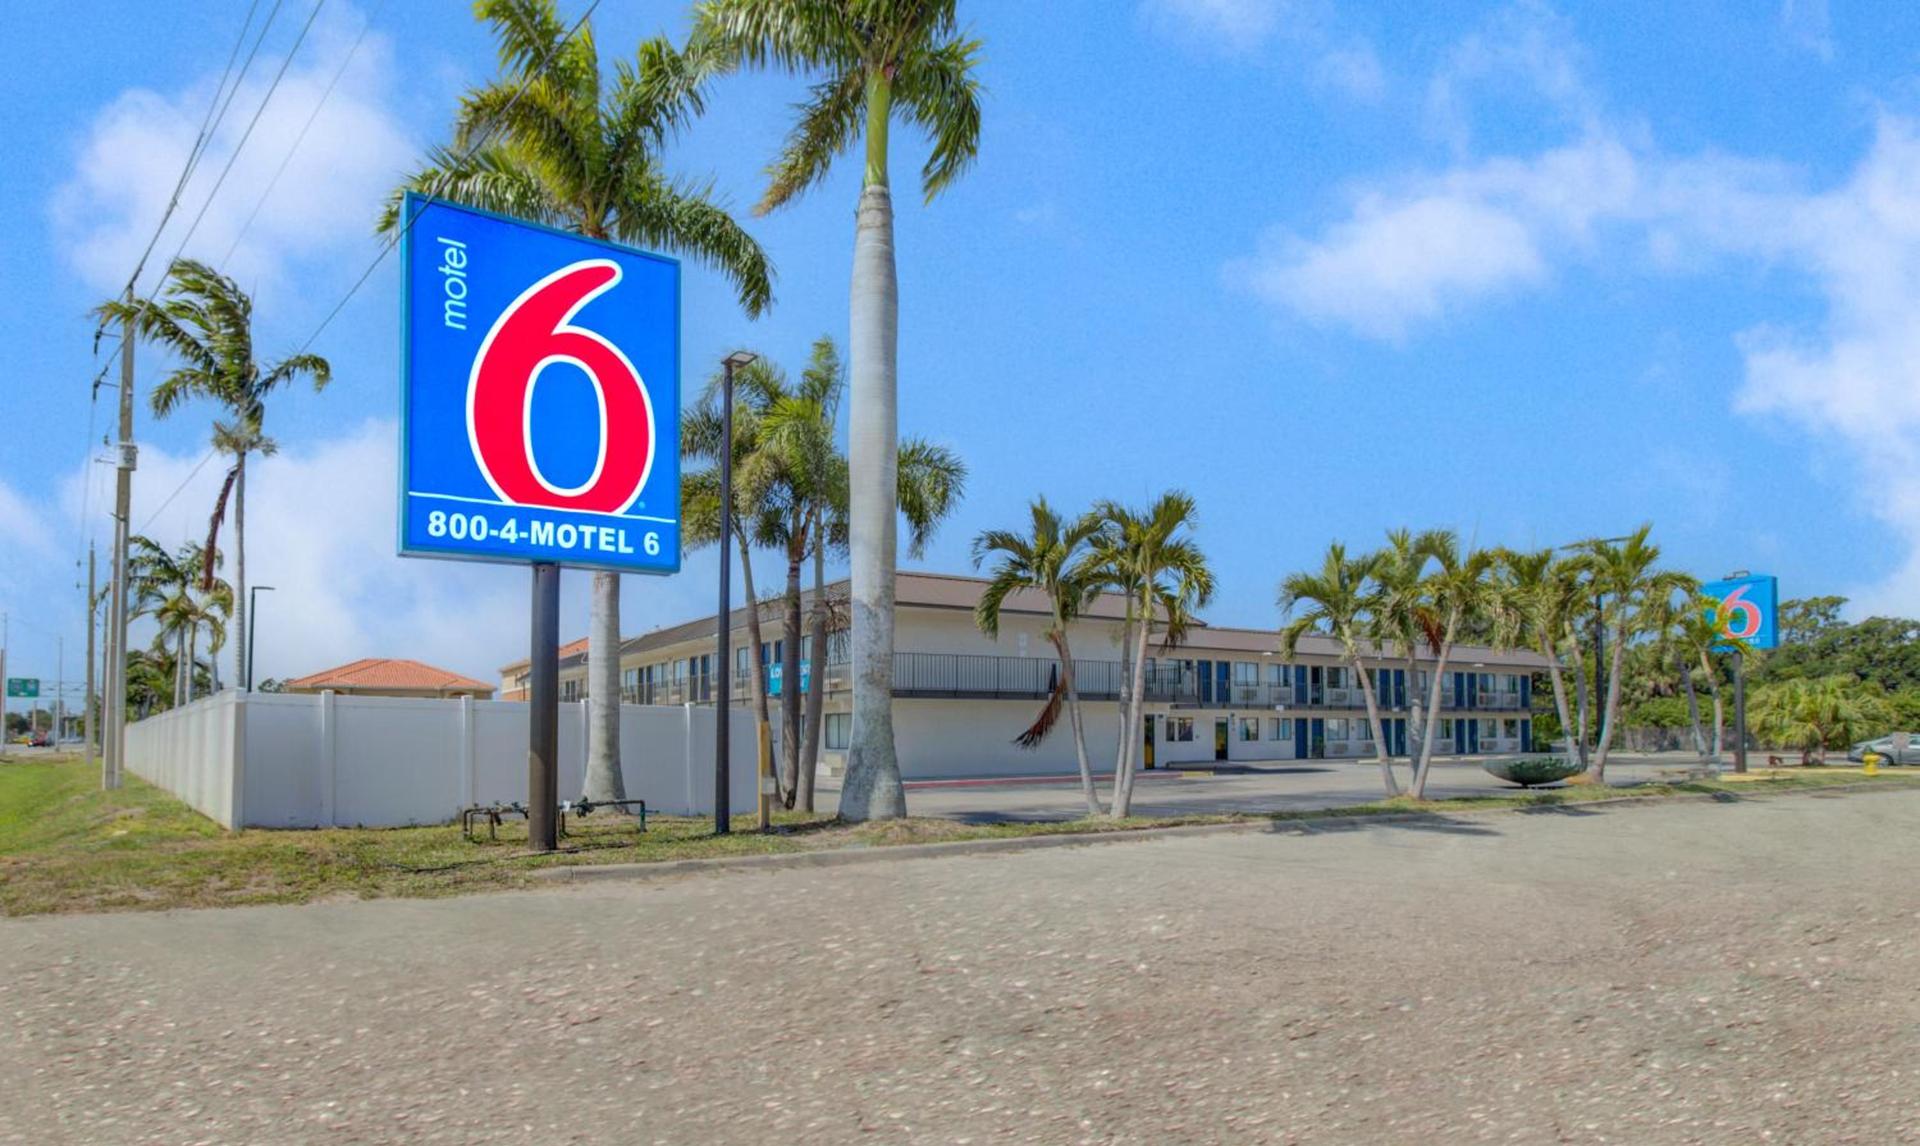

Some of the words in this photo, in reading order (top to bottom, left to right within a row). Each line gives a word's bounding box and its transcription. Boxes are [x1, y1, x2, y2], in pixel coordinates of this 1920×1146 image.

[437, 237, 467, 329] motel
[467, 259, 656, 514] 6
[428, 511, 633, 554] 800-4-MOTEL
[643, 531, 660, 556] 6
[1716, 584, 1761, 639] 6
